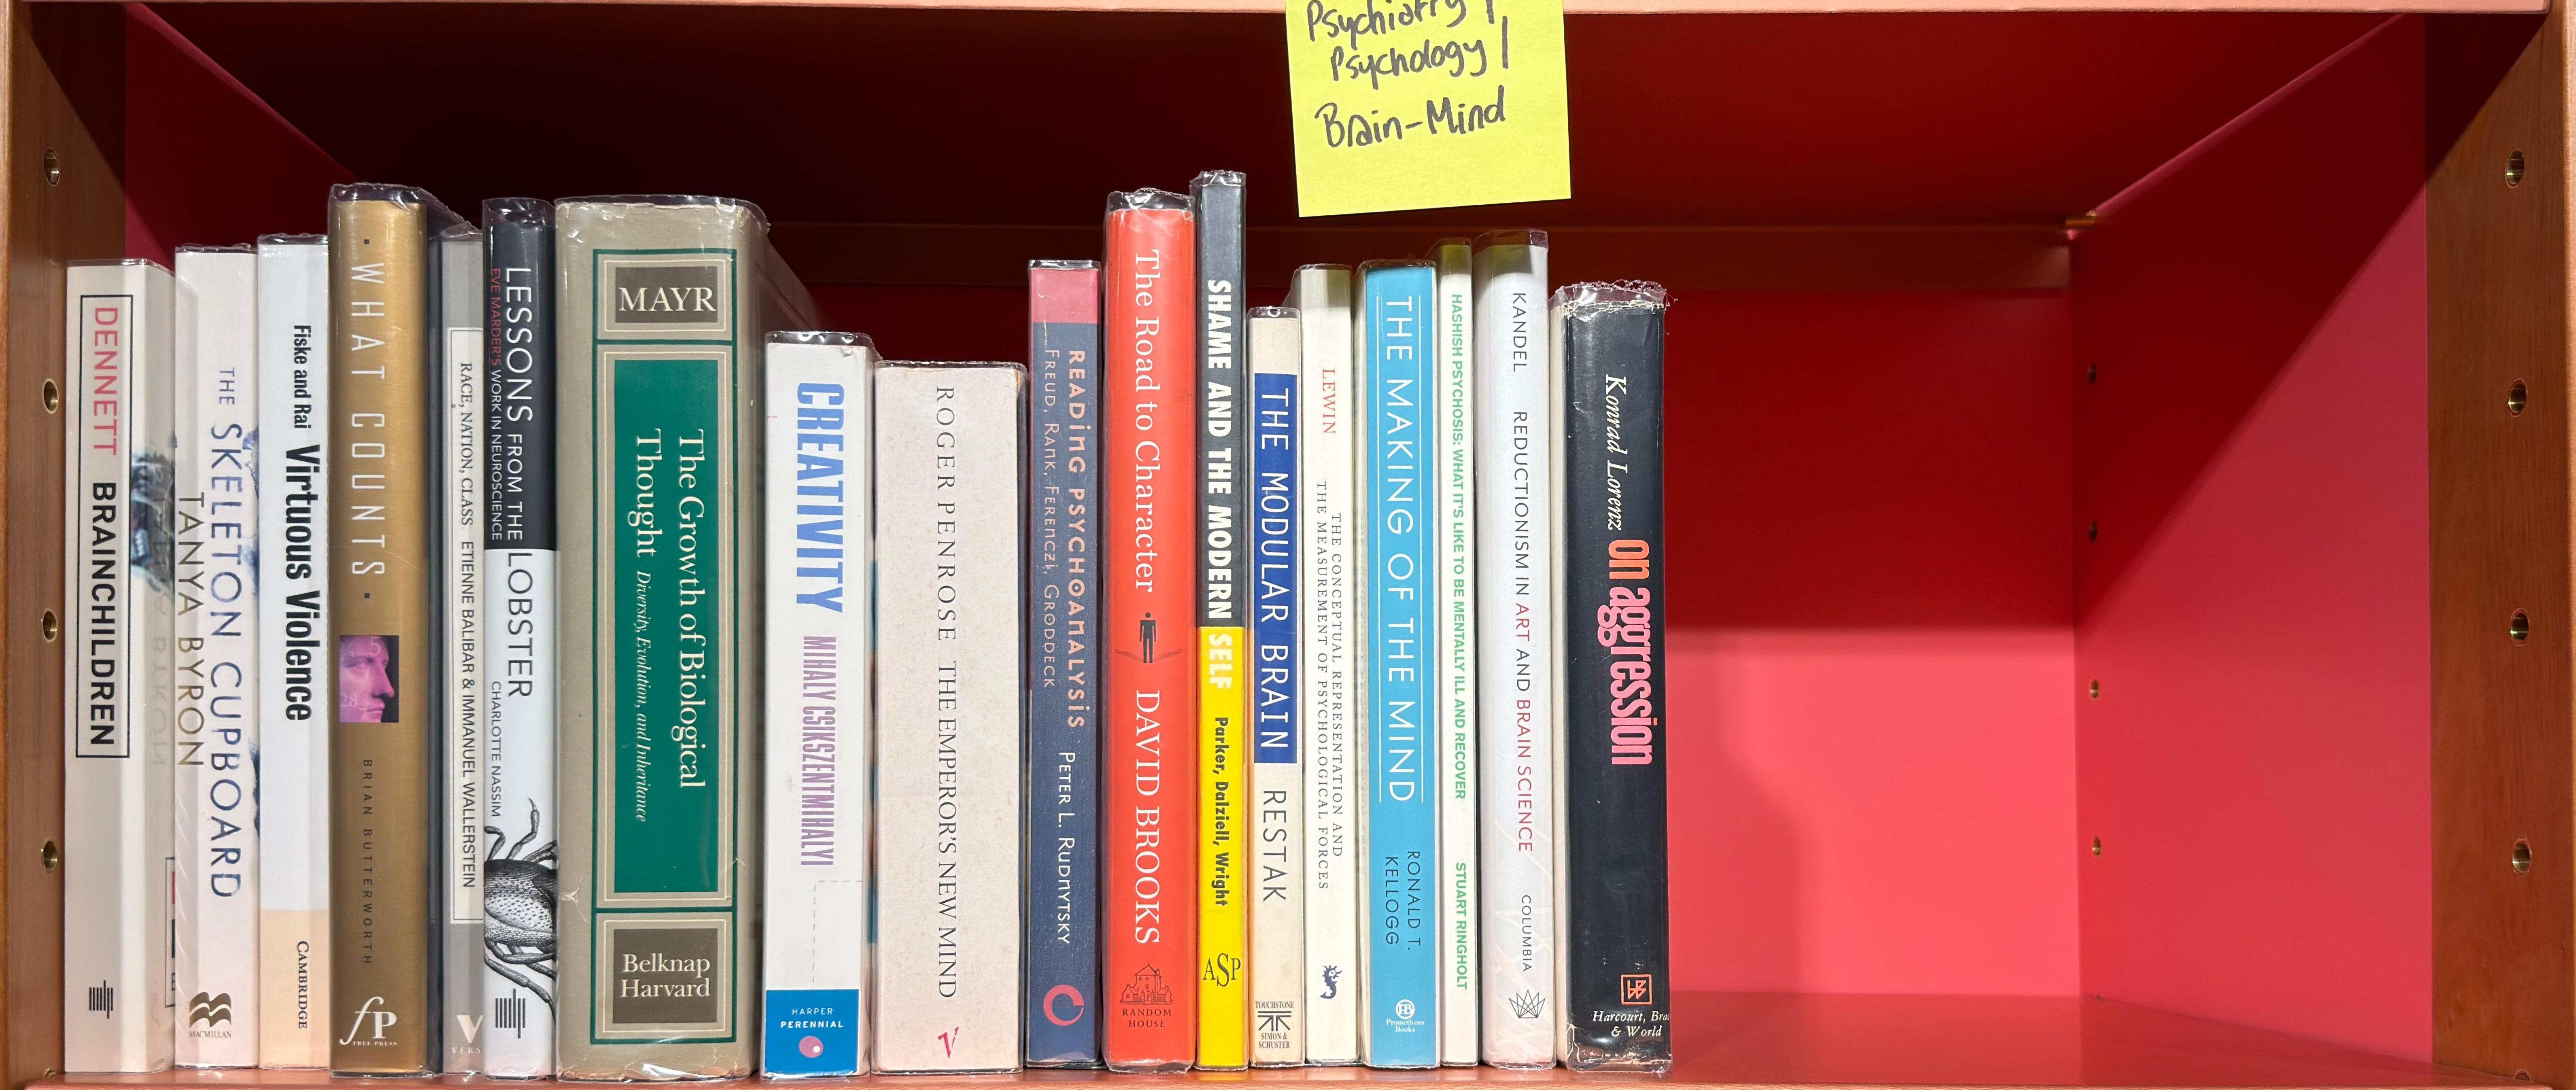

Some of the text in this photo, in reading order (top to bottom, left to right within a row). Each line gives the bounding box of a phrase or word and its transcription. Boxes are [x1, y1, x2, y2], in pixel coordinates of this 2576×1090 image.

[1314, 85, 1506, 148] Brain-Mind
[1330, 40, 1487, 90] Psychology
[618, 286, 717, 312] MAYR
[1512, 293, 1527, 373] KANDEL
[293, 325, 312, 429] Fiske and Rai
[351, 263, 386, 575] WHAT COUNTS
[491, 268, 503, 541] EVE MARDER'S WORK IN NEUROSCIENCE
[1135, 248, 1161, 593] The Road to Character
[1322, 368, 1336, 434] LEWIN
[506, 267, 533, 698] LESSONS FROM THE LOBSTER
[627, 428, 663, 558] Thought
[796, 382, 845, 613] CREATIVITY
[936, 386, 956, 641] ROGER PENROSE
[1208, 280, 1233, 689] SHAME AND THE MODERN SELF
[1605, 373, 1628, 531] Konrad Lorenz
[91, 307, 119, 745] DENNETT BRAINCHILDREN
[285, 444, 321, 721] Virtuous Violence
[1260, 388, 1290, 748] THE MODULAR BRAIN
[1386, 295, 1416, 802] THE MAKING OF THE MIND
[1451, 294, 1466, 799] HASHISH PSYCHOSIS: WHAT IT'S LIKE TO BE MENTALLY ILL AND RECOVER
[177, 492, 205, 766] TANYA BYRON
[210, 367, 243, 897] THE SKELETON CUPBOARD
[458, 362, 476, 888] RACE, NATION, CLASS ETIENNE BALIBAR & IMMANUEL WALLERSTEIN
[671, 428, 707, 788] The Growth of Biological
[1513, 411, 1533, 852] REDUCTIONISM IN ART AND BRAIN SCIENCE
[1597, 539, 1659, 765] on aggression
[491, 681, 502, 817] CHARLOTTE NASSIM
[633, 570, 652, 822] Diversity, Evolution, and Inheritance
[1317, 480, 1329, 889] THE MEASUREMENT OF PSYCHOLOGICAL FORCES
[1331, 512, 1343, 857] THE CONCEPTUAL REPRESENTATION AND
[801, 636, 837, 865] MIHALY CSIKSZENTMIHALYI
[1058, 752, 1076, 805] PETER
[1211, 717, 1230, 906] Parker, Dalziell, Wright
[363, 759, 373, 964] BRIAN BUTTERWORTH
[938, 660, 957, 998] THE EMPEROR'S NEW MIND
[1058, 812, 1076, 828] L.
[1134, 689, 1160, 944] DAVID BROOKS
[1262, 790, 1288, 902] RESTAK
[622, 952, 711, 979] Belknap
[1385, 856, 1399, 945] KELLOGG
[1407, 851, 1421, 951] RONALD T.
[1455, 862, 1467, 990] STUART RINGHOLT
[1521, 894, 1533, 972] COLUMBIA
[189, 1030, 232, 1038] MACMILLAN
[297, 940, 310, 1029] CAMBRIDGE
[620, 978, 711, 998] Harvard
[780, 1020, 844, 1029] PERENNIAL
[792, 1007, 833, 1016] HARPER
[1122, 1008, 1172, 1016] RANDOM
[1128, 1020, 1164, 1028] HOUSE
[1202, 952, 1241, 988] ASP
[1255, 1001, 1293, 1009] TOUCHSTONE
[1386, 1017, 1425, 1026] Prometheus
[1592, 1009, 1646, 1023] Harcourt,
[1611, 1024, 1663, 1037] & World
[1258, 1041, 1290, 1049] SCHUSTER
[1261, 1032, 1288, 1040] SIMON &
